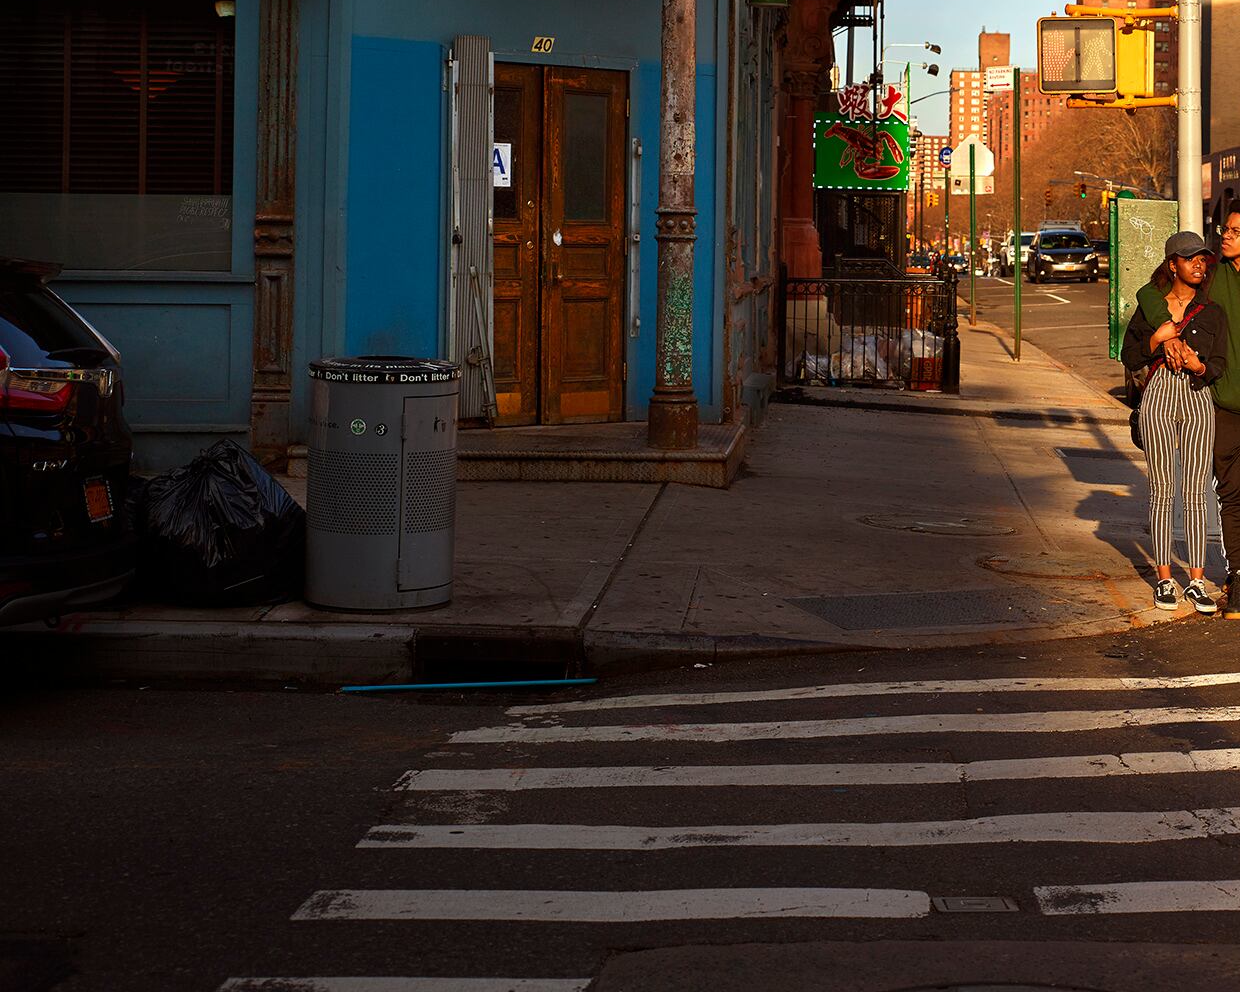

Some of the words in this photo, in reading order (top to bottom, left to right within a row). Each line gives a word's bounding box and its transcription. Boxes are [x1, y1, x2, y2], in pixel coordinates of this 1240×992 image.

[534, 38, 553, 52] 40
[494, 148, 506, 174] A
[325, 371, 349, 382] Don't
[352, 373, 379, 382] litter
[400, 373, 428, 382] Don't
[431, 372, 450, 381] litter
